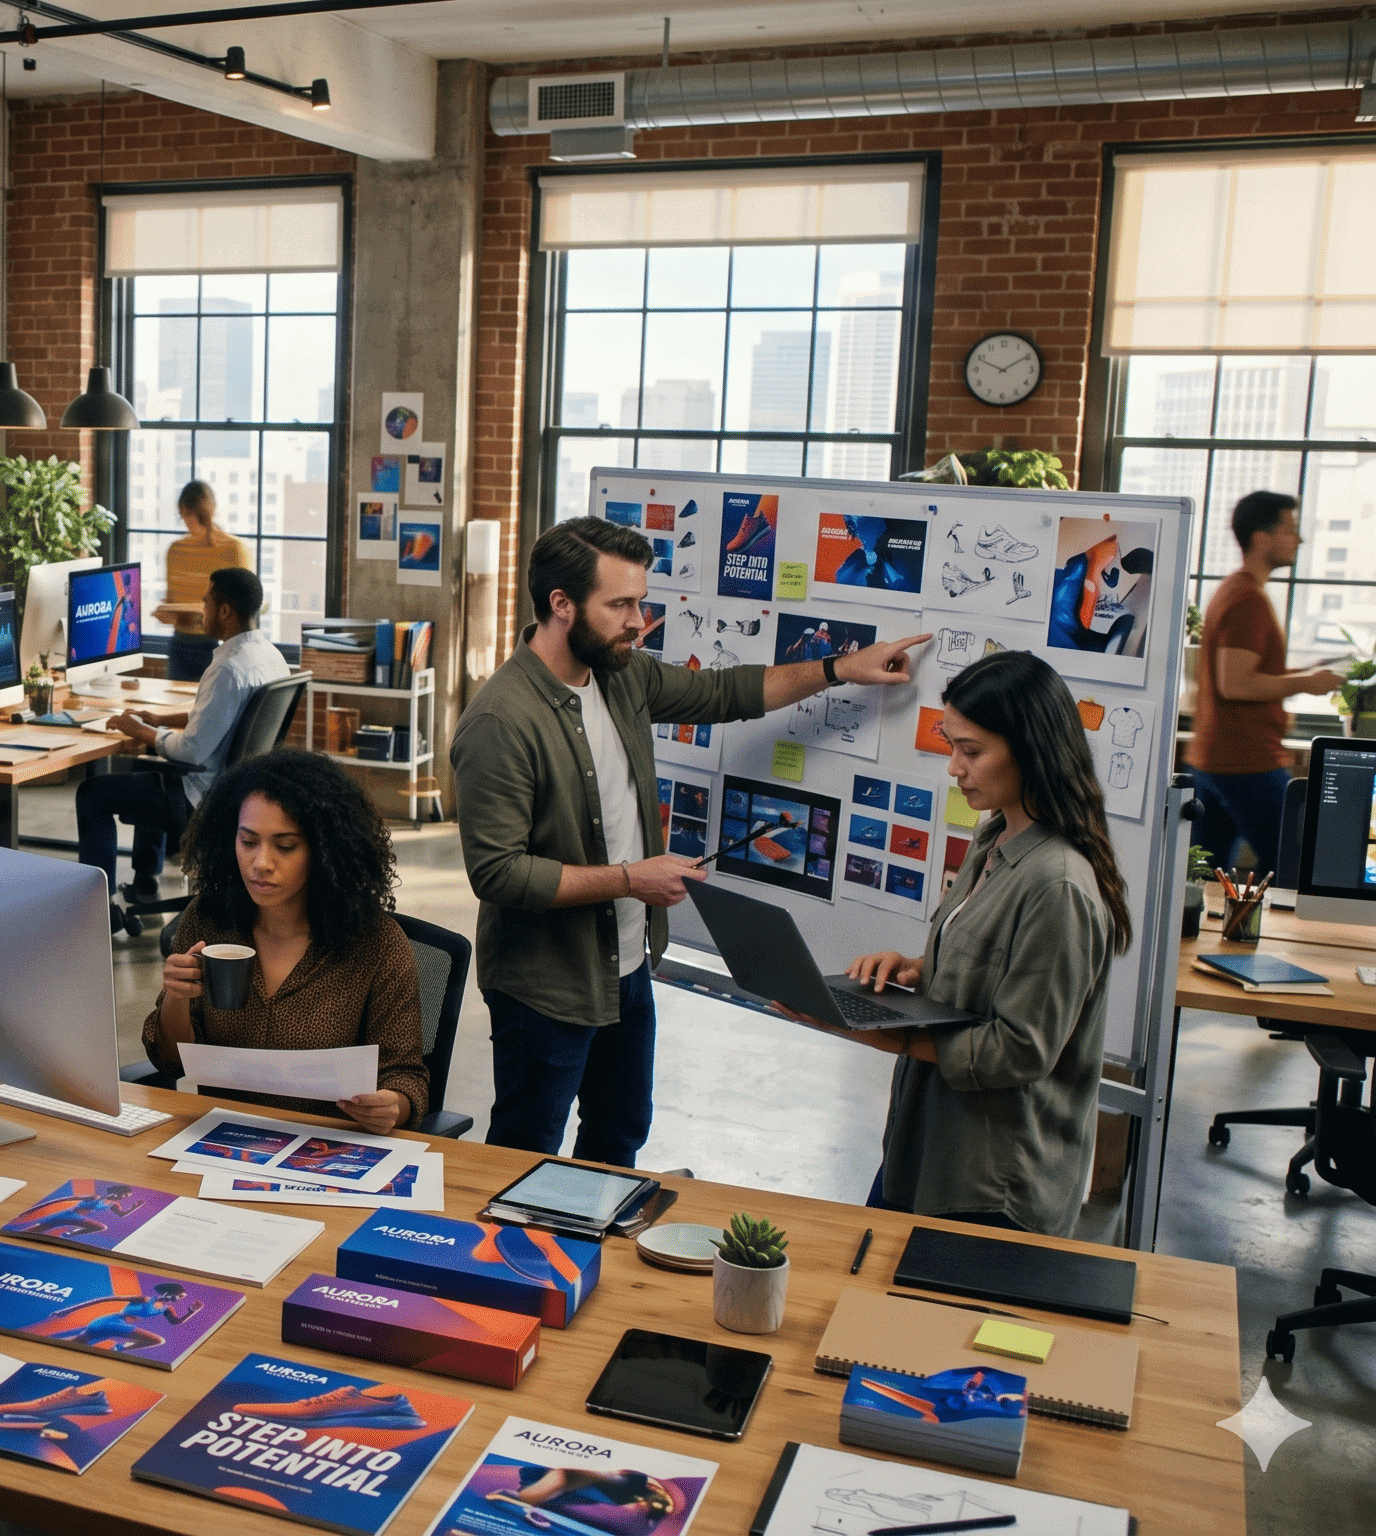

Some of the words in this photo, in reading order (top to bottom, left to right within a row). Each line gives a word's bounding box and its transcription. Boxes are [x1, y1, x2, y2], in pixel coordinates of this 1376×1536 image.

[726, 553, 747, 566] STEP
[724, 565, 767, 581] POTENTIAL
[373, 1225, 455, 1245] AURORA
[312, 1286, 399, 1309] AURORA
[254, 1363, 328, 1384] AURORA
[207, 1412, 307, 1447] STEP
[303, 1435, 402, 1472] INTO
[513, 1431, 612, 1459] AURORA
[179, 1429, 388, 1498] POTENTIAL
